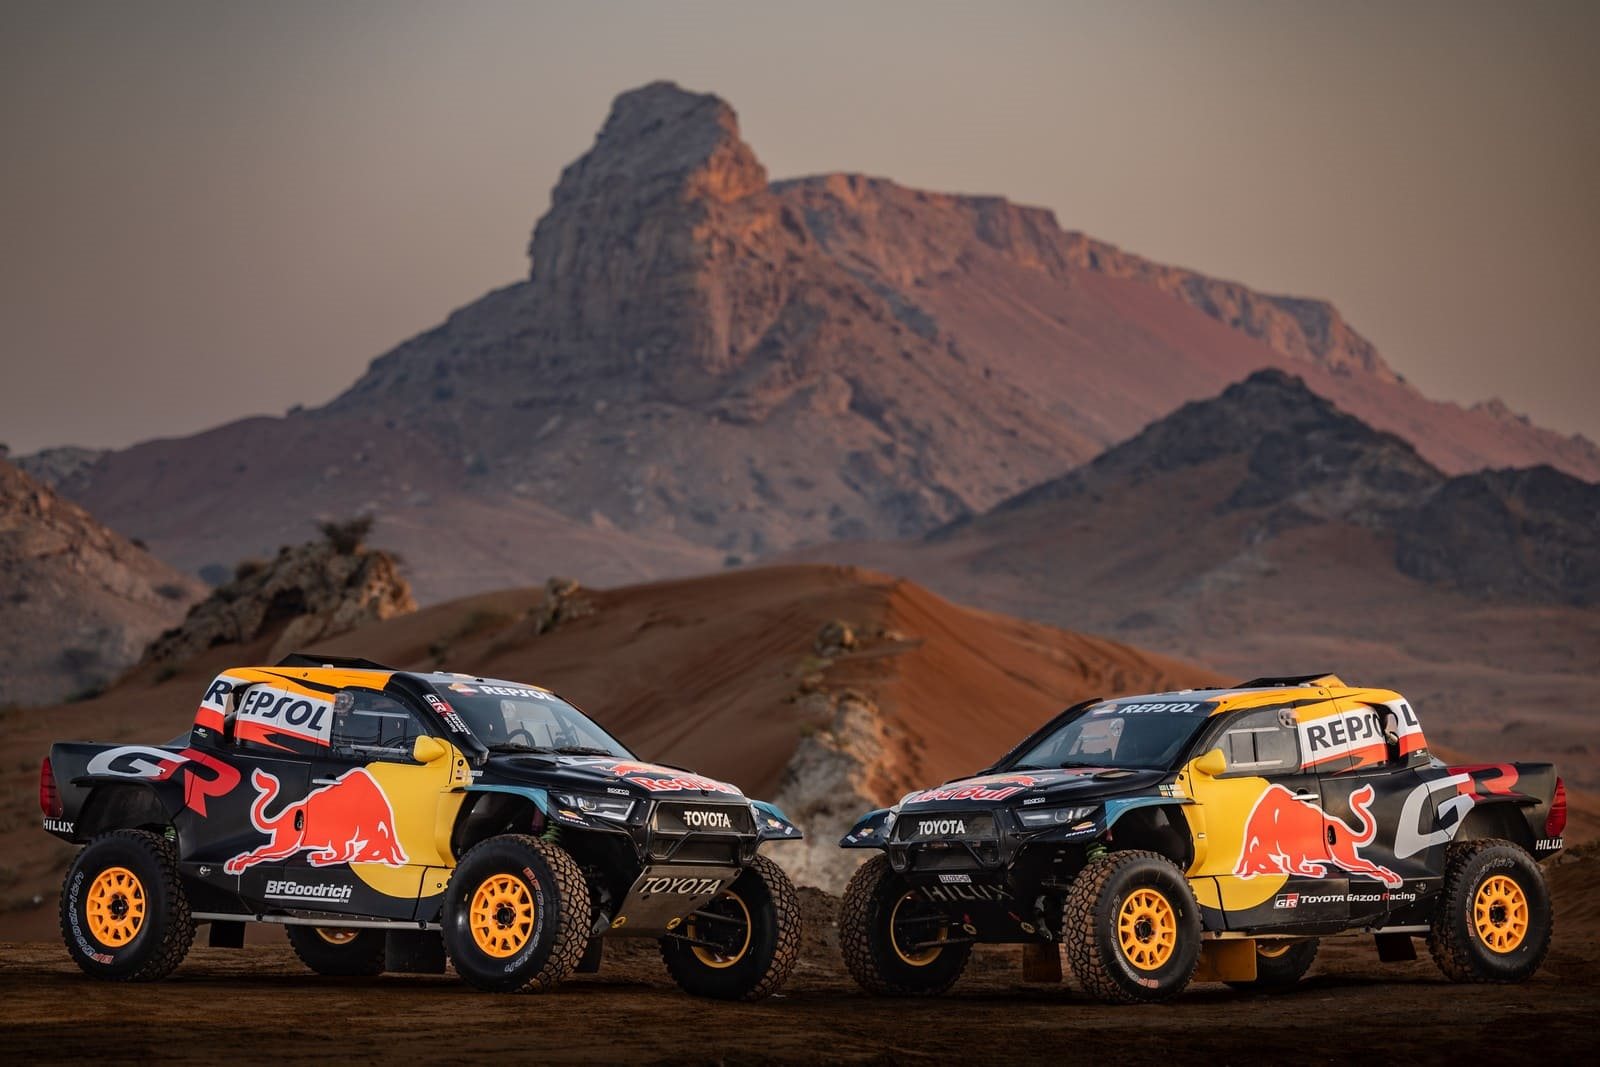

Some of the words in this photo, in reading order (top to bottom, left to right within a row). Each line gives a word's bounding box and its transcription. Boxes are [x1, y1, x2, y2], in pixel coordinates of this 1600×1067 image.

[479, 685, 555, 701] REPSOL
[1118, 703, 1200, 714] REPSOL
[42, 819, 75, 834] HILUX
[684, 811, 731, 828] TOYOTA
[918, 820, 966, 835] TOYOTA
[1535, 839, 1564, 850] HILUX
[265, 880, 353, 898] BFGoodrich
[639, 877, 721, 895] TOYOTA
[1273, 892, 1299, 909] GR
[1300, 894, 1345, 904] TOYOTA
[1346, 893, 1381, 902] GAZOO
[1382, 891, 1416, 902] Racing
